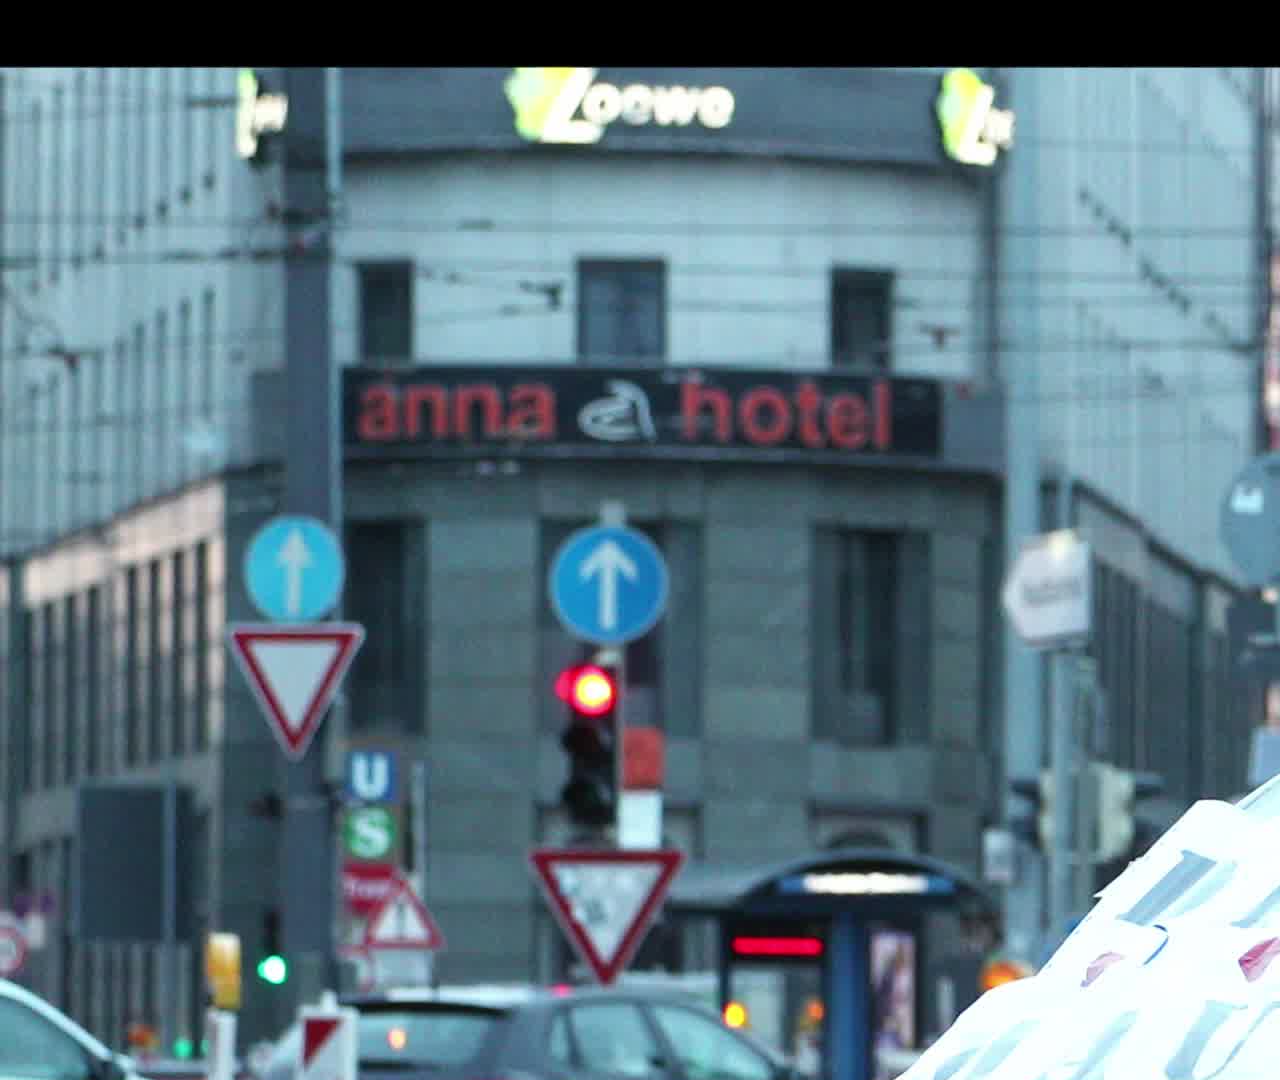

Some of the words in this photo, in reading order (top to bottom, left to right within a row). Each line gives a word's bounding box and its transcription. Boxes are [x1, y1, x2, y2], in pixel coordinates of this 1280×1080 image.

[357, 380, 557, 440] anna
[682, 374, 891, 449] hotel
[352, 752, 390, 800] U
[350, 810, 391, 859] S
